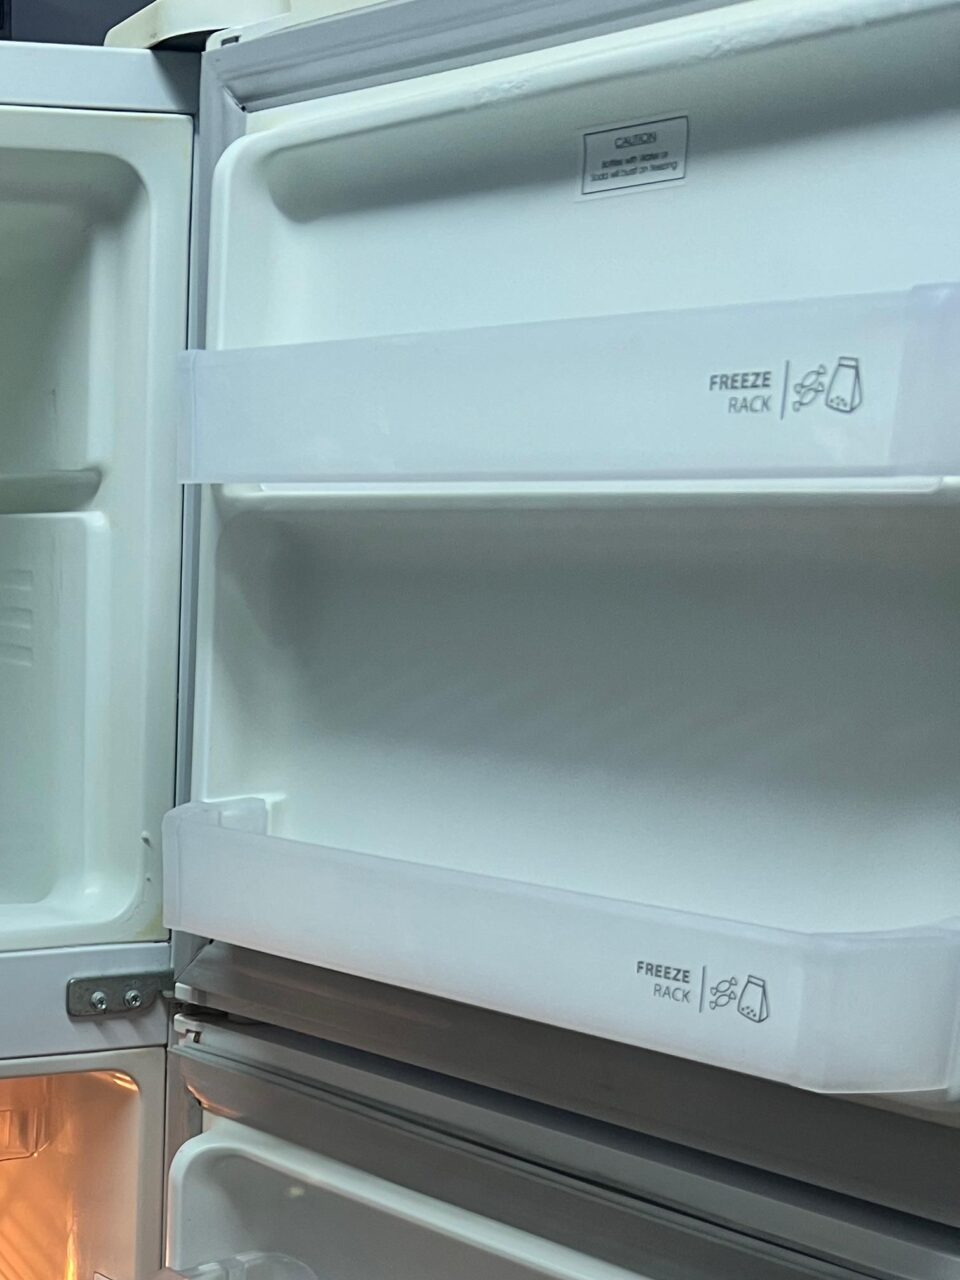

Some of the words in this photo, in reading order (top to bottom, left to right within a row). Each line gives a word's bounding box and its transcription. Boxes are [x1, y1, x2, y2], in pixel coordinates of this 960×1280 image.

[709, 370, 772, 391] FREEZE
[728, 395, 772, 414] RACK
[636, 960, 690, 984] FREEZE
[653, 983, 691, 1003] RACK
